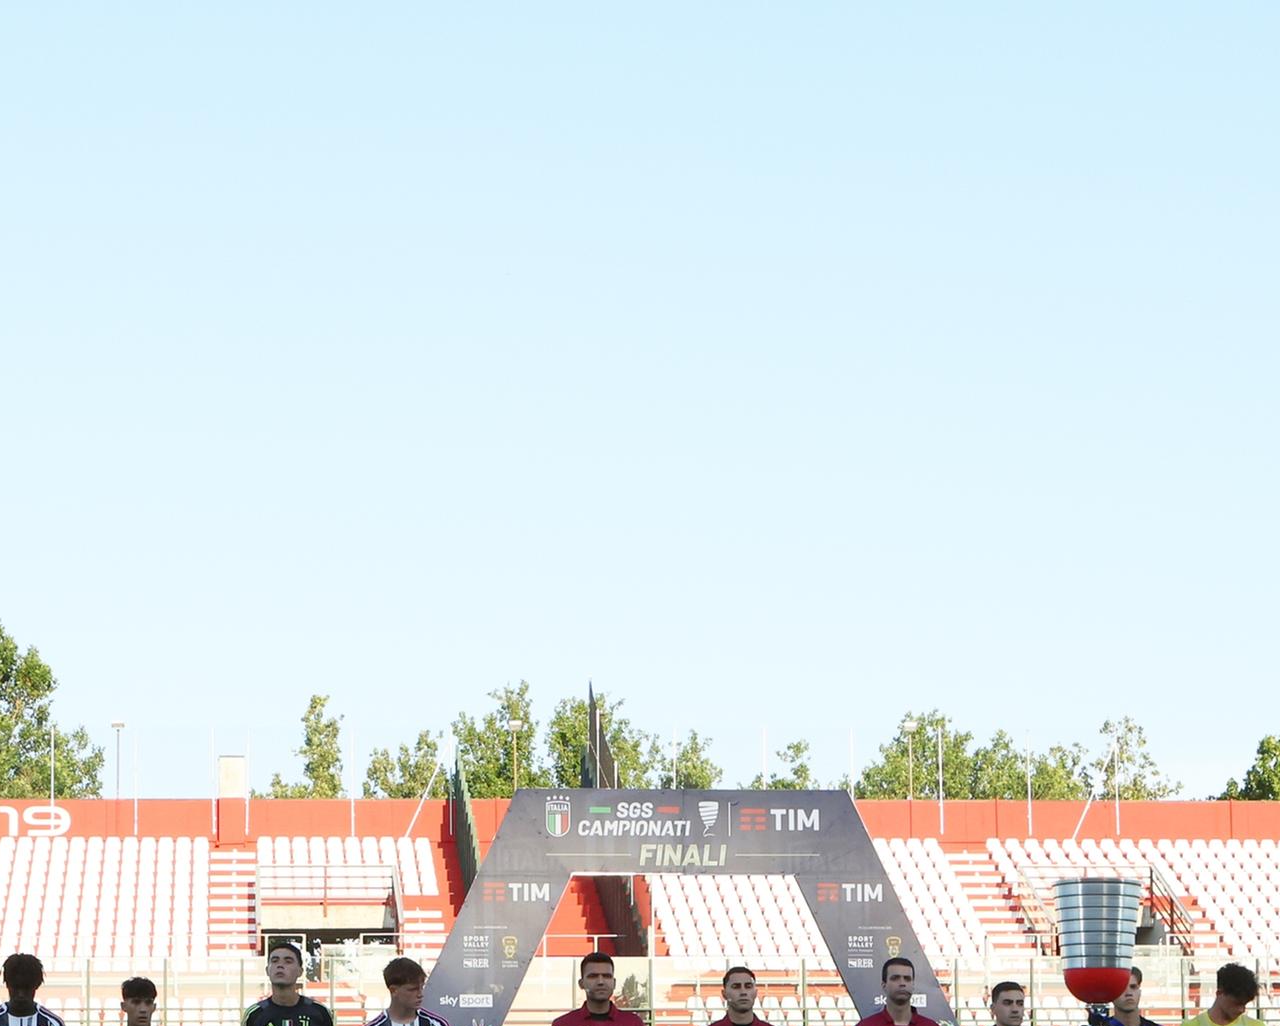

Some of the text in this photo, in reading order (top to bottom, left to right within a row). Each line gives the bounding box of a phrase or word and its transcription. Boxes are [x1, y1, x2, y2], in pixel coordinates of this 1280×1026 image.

[616, 801, 653, 819] SGS
[770, 808, 820, 832] TIM
[577, 819, 691, 838] CAMPIONATI
[639, 843, 727, 867] FINALI
[508, 882, 550, 902] TIM
[842, 883, 883, 903] TIM
[440, 994, 491, 1007] sky sport
